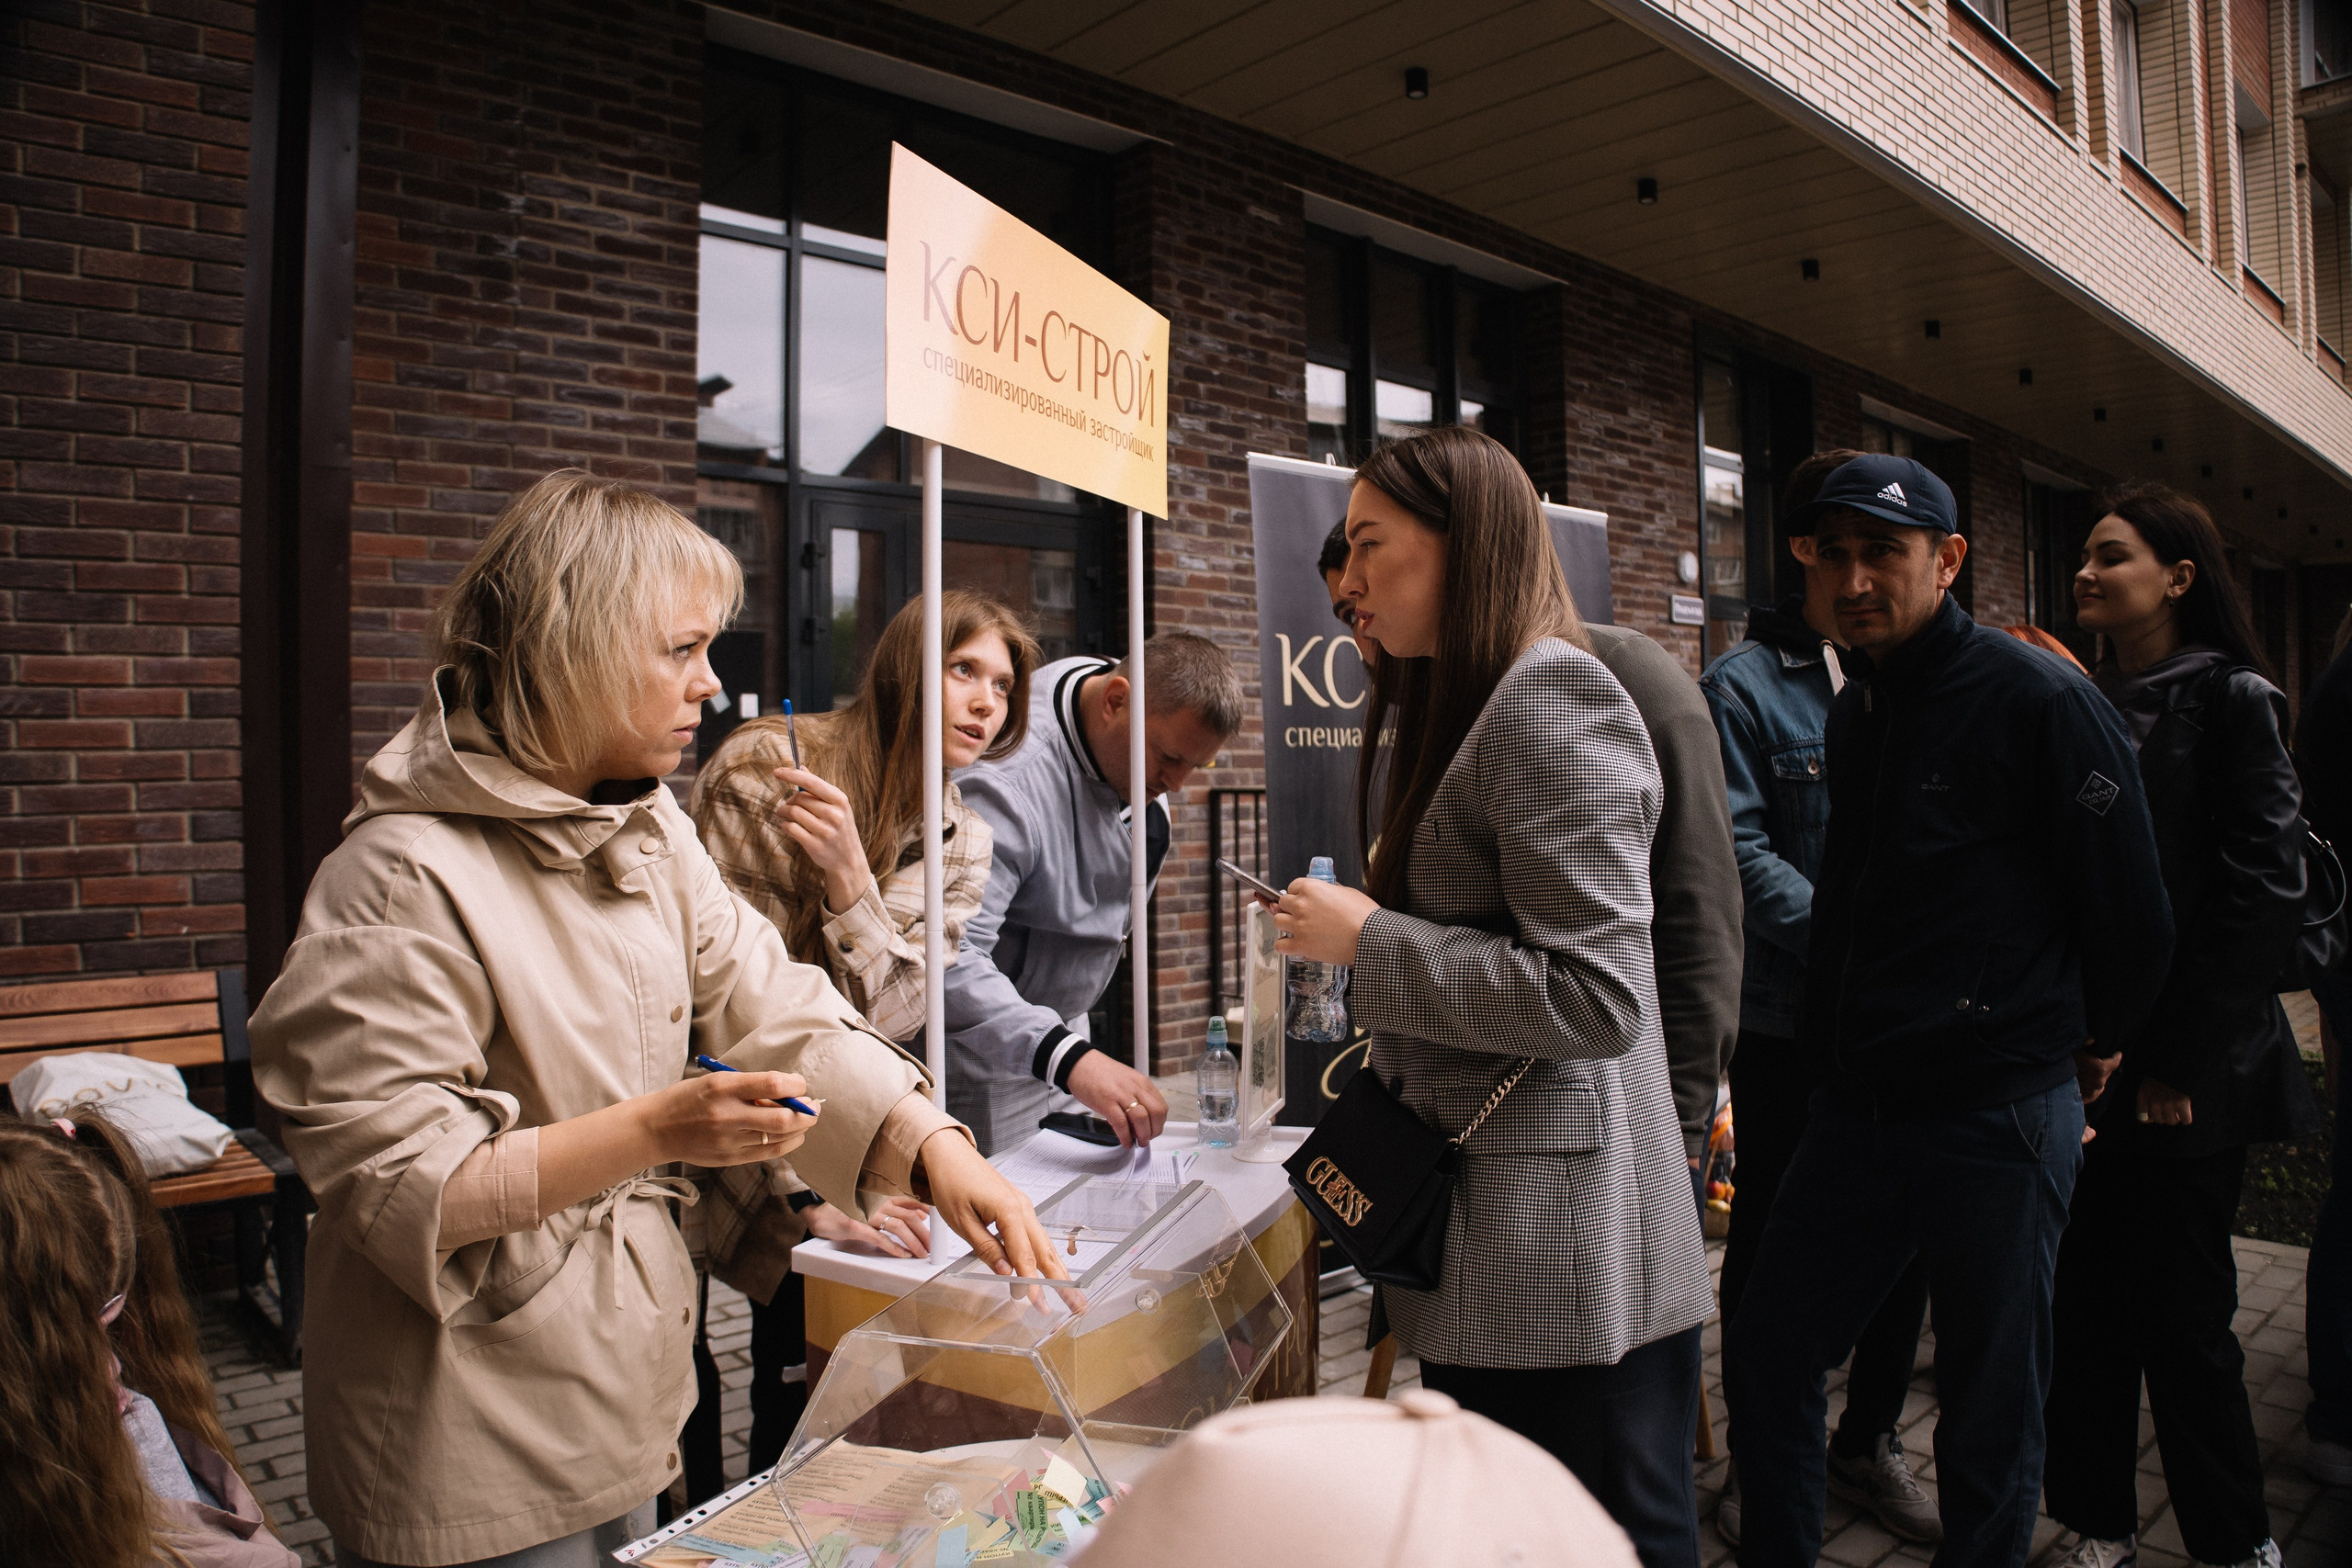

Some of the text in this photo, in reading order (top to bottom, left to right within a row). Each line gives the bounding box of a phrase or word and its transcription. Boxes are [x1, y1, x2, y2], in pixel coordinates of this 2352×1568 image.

[920, 240, 1154, 428] КСИ-СТРОЙ
[923, 346, 1154, 463] специализированный застройщик
[1877, 491, 1907, 507] adidas
[1275, 633, 1366, 710] КС
[1306, 1156, 1374, 1227] GUESS
